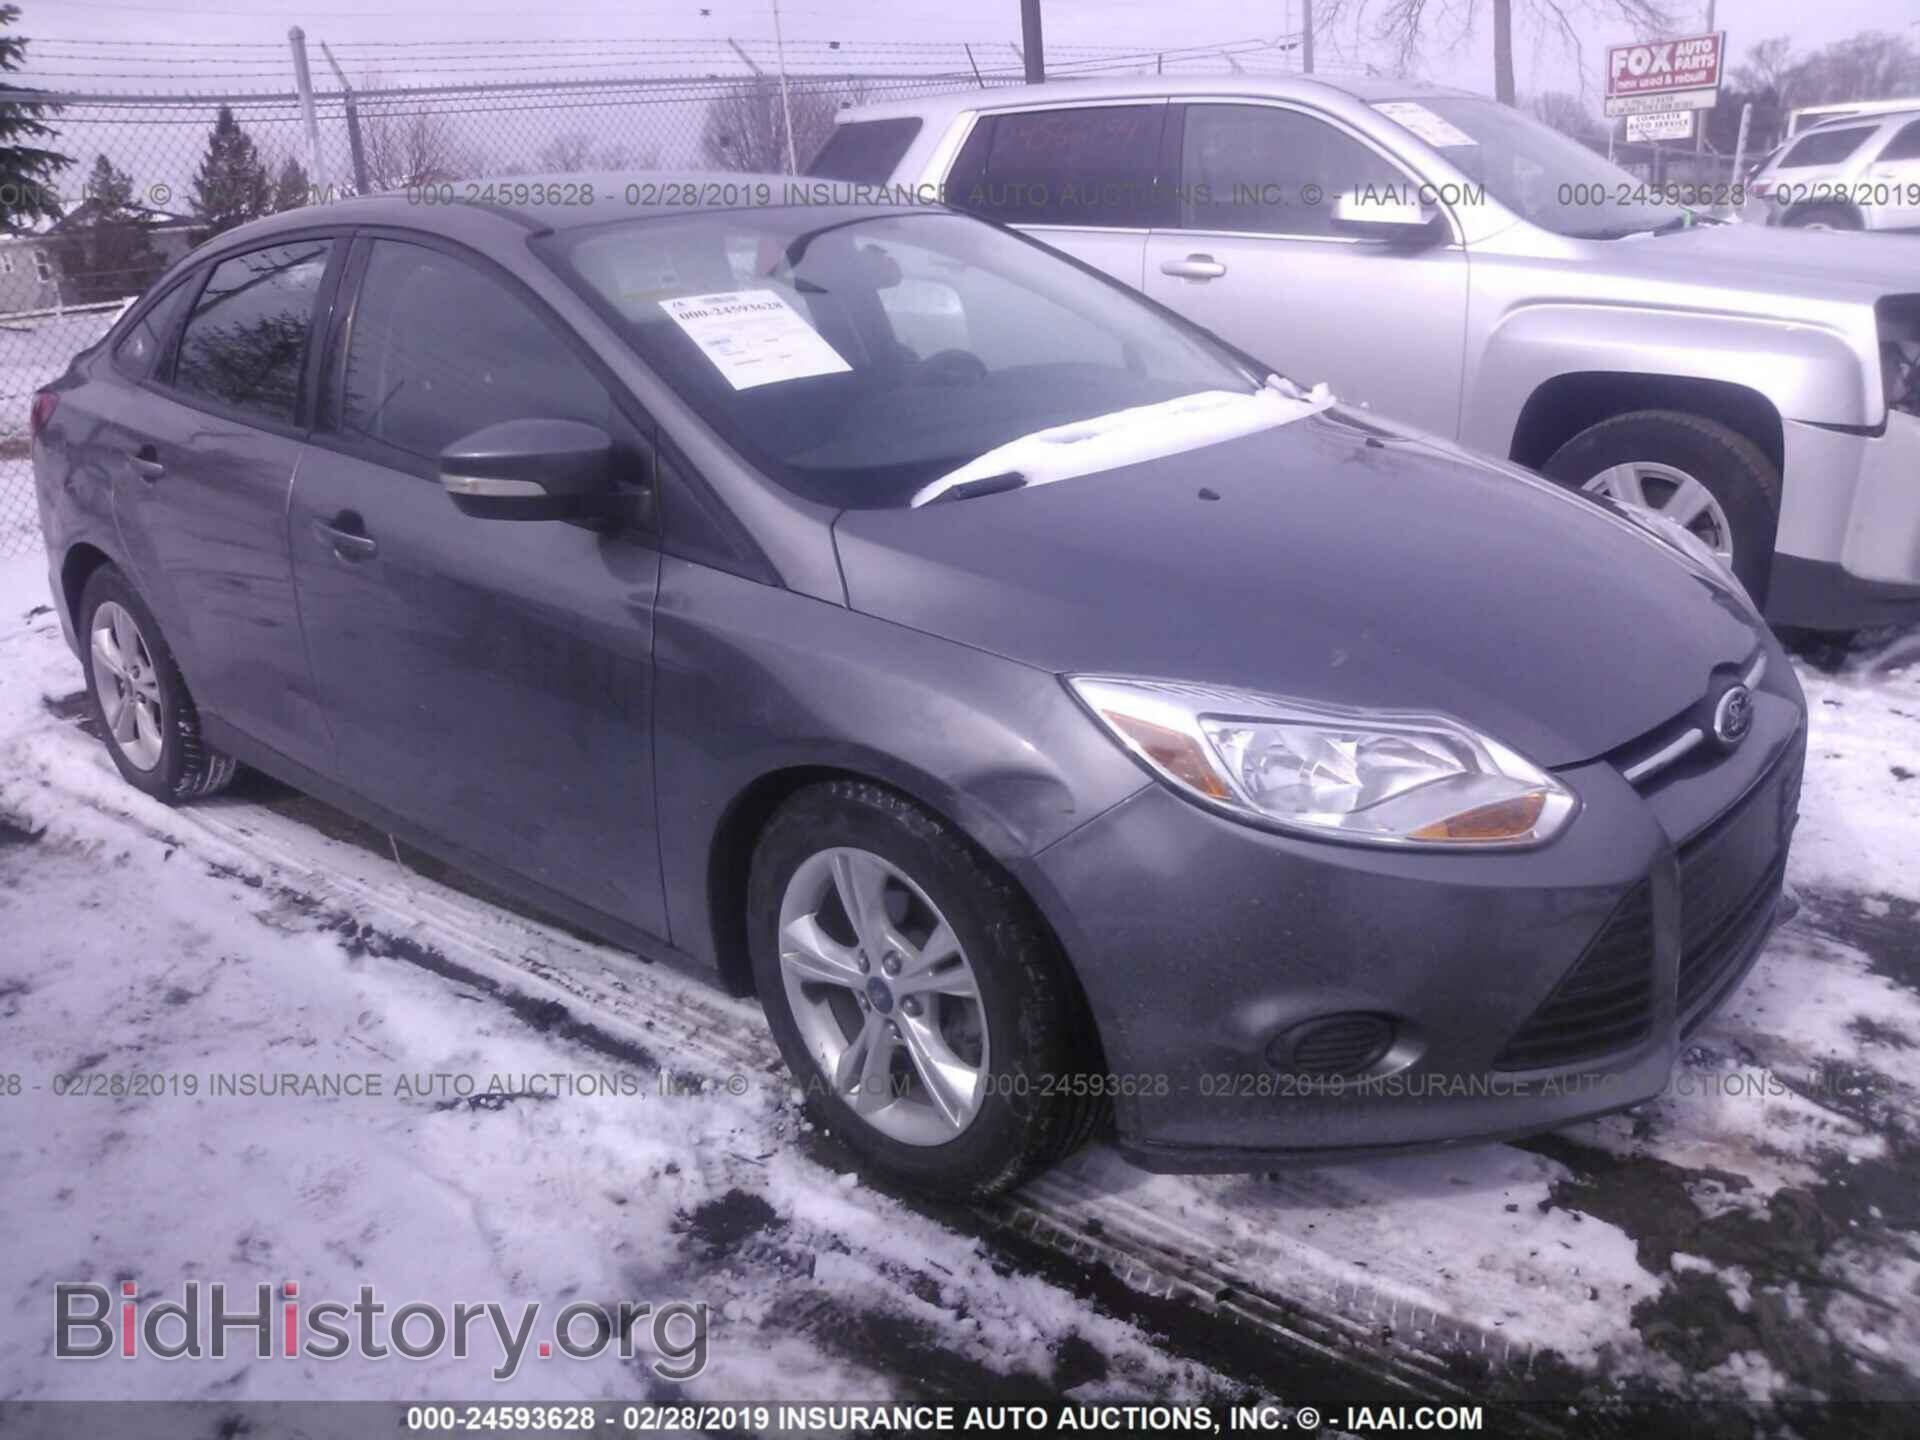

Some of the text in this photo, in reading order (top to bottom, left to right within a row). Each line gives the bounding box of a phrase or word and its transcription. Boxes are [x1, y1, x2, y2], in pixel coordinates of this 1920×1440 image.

[1675, 39, 1713, 57] AUTO
[1612, 43, 1673, 78] FOX
[1674, 53, 1716, 72] PARTS
[1629, 121, 1653, 130] AUTO
[1636, 112, 1681, 122] COMPLETE
